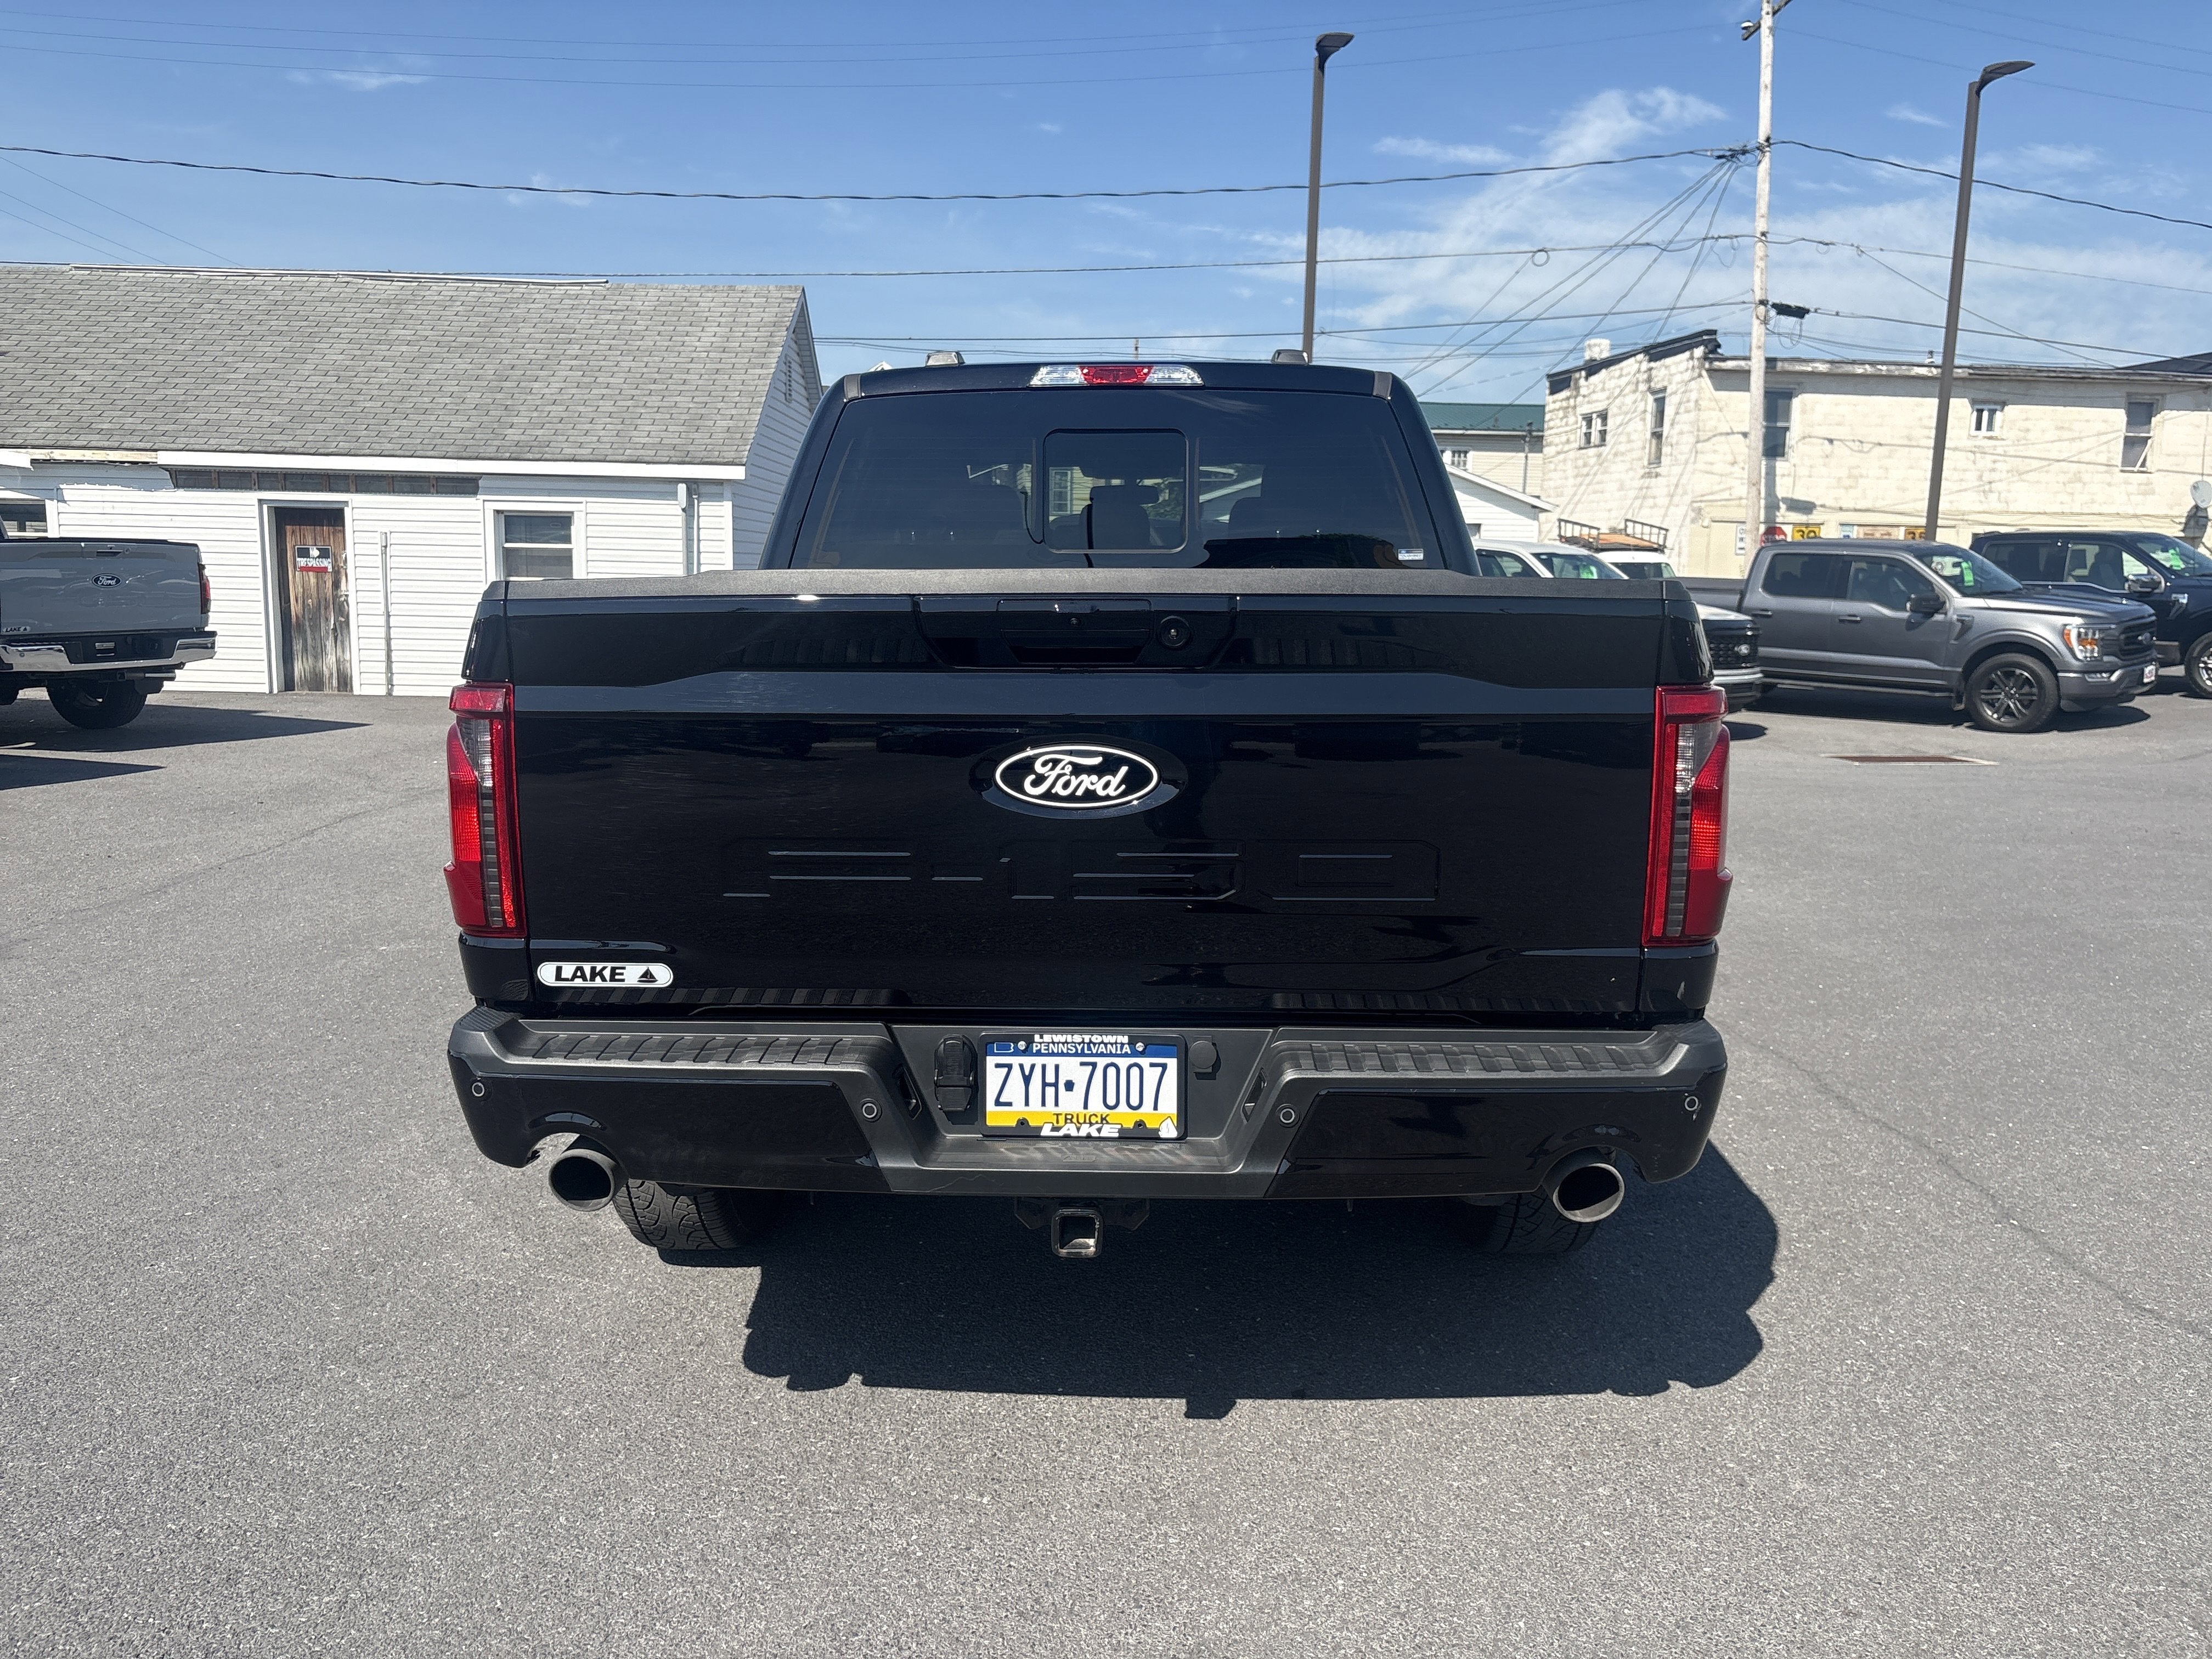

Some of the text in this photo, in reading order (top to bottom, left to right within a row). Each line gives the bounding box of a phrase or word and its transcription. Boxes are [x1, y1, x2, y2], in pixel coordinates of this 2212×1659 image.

[98, 576, 116, 585] Ford
[1024, 754, 1128, 796] Ford
[555, 966, 626, 982] LAKE
[1034, 1034, 1128, 1043] LEWISTOWN
[1033, 1043, 1131, 1054] PENNSYLVANIA
[1053, 1113, 1110, 1125] TRUCK
[1040, 1123, 1121, 1137] LAKE
